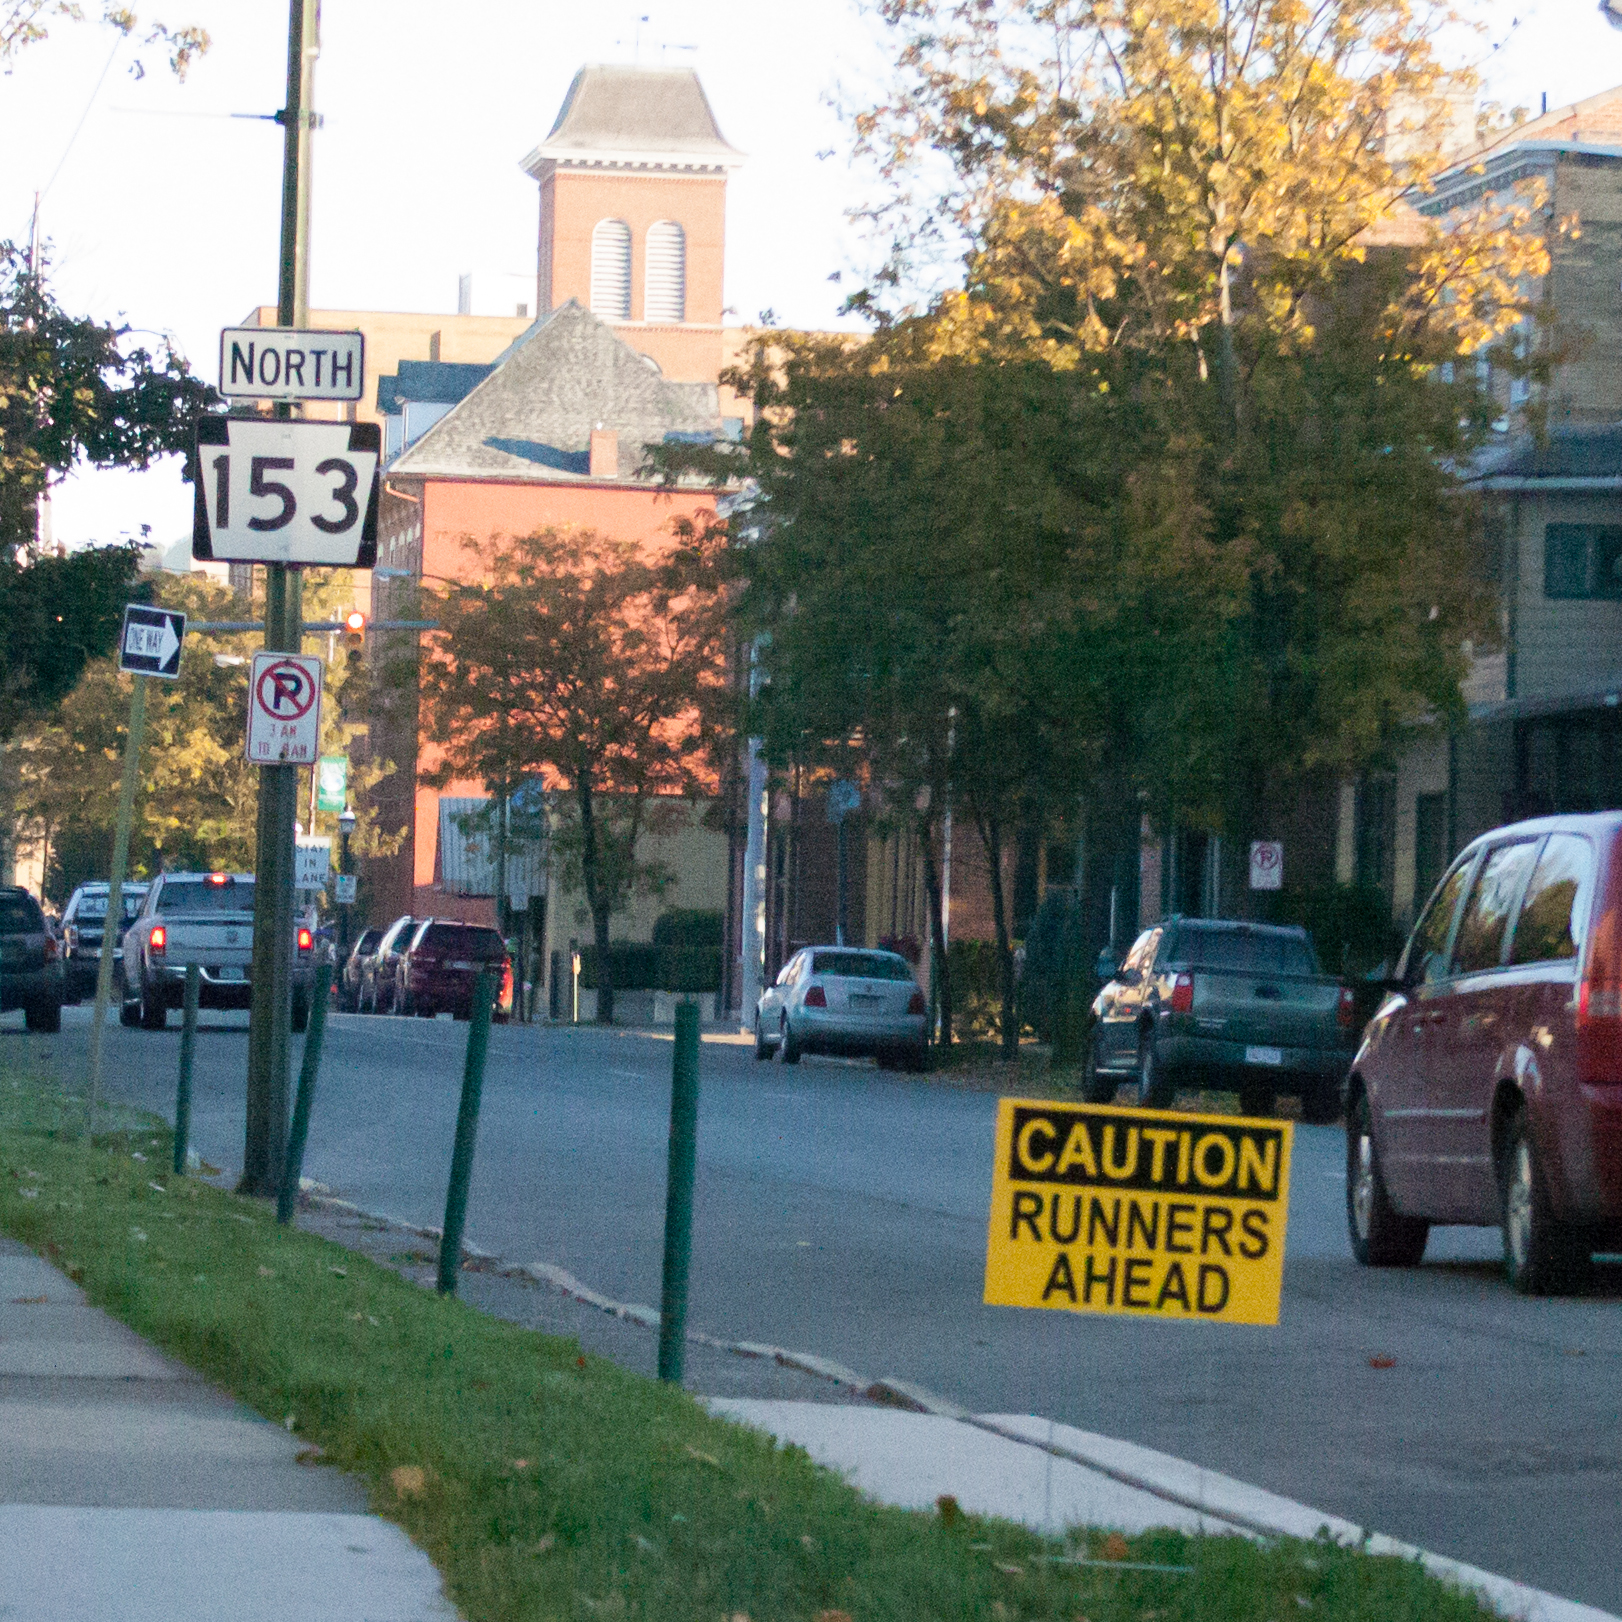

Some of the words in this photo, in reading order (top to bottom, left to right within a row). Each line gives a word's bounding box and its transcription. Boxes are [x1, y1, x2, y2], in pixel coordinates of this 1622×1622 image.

[231, 341, 353, 387] NORTH
[212, 454, 360, 534] 153
[127, 627, 145, 650] ONE
[145, 630, 165, 653] WAY
[296, 844, 325, 854] STAY
[303, 858, 316, 868] IN
[301, 873, 326, 883] ANE
[1017, 1118, 1278, 1192] CAUTION
[1010, 1190, 1270, 1259] RUNNERS
[1042, 1252, 1230, 1314] AHEAD
